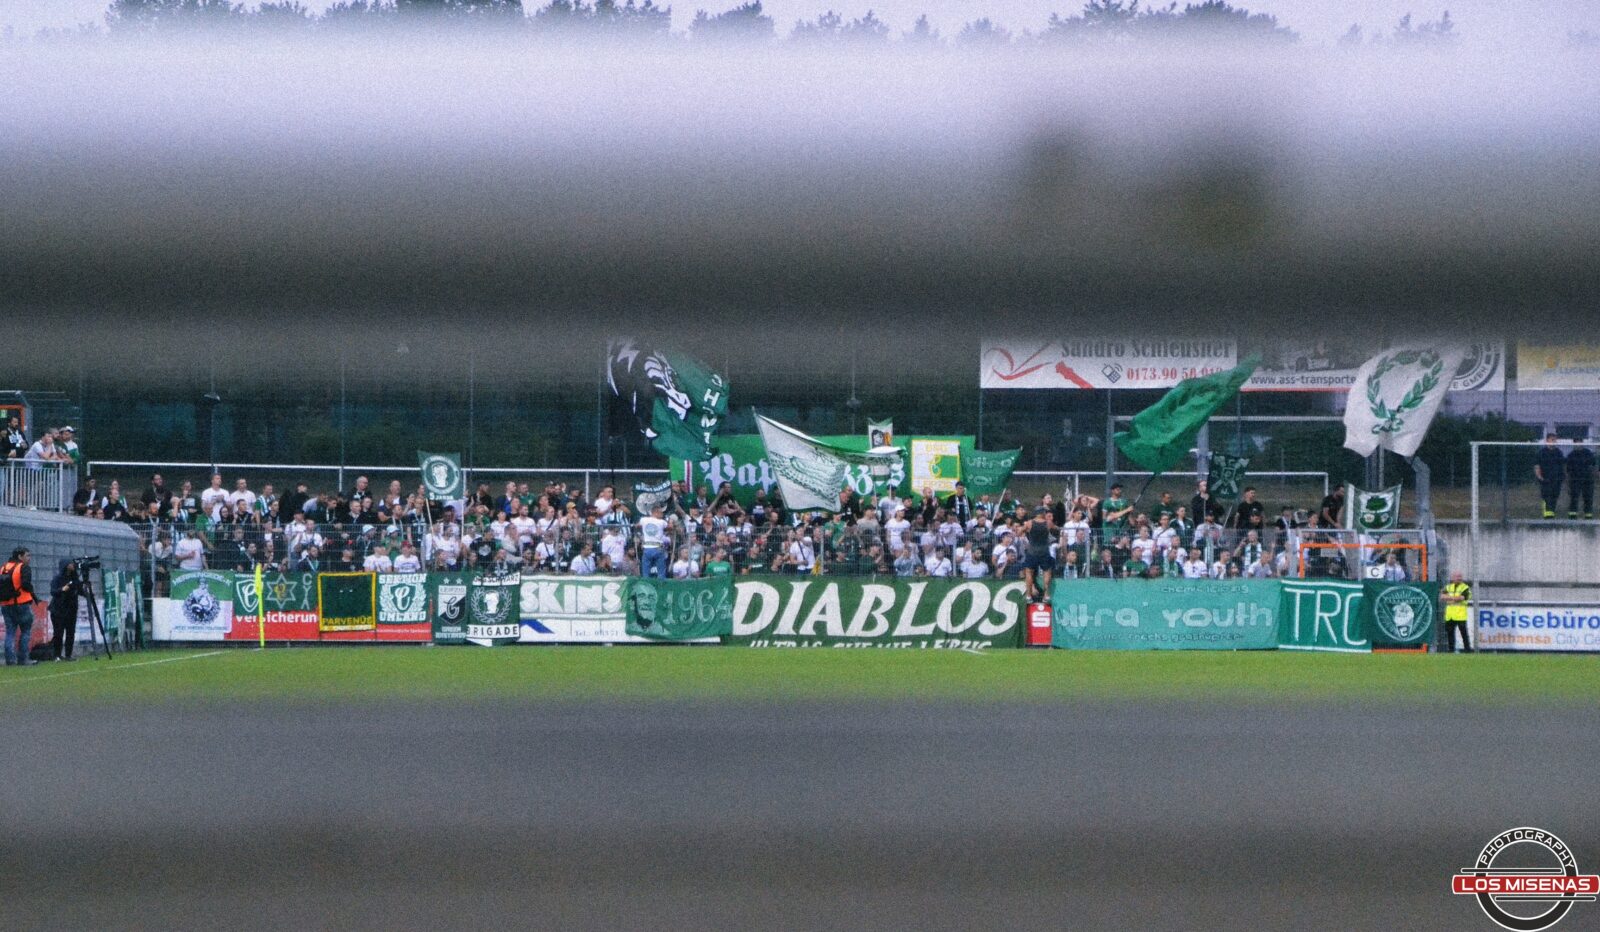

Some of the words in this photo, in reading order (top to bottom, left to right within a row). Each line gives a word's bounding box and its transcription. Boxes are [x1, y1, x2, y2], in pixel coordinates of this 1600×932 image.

[732, 581, 1027, 636] DIABLOS
[1284, 587, 1367, 646] TRC
[1479, 610, 1600, 629] Reisebüro
[467, 625, 518, 636] BRIGADE
[1480, 632, 1552, 645] Lufthansa
